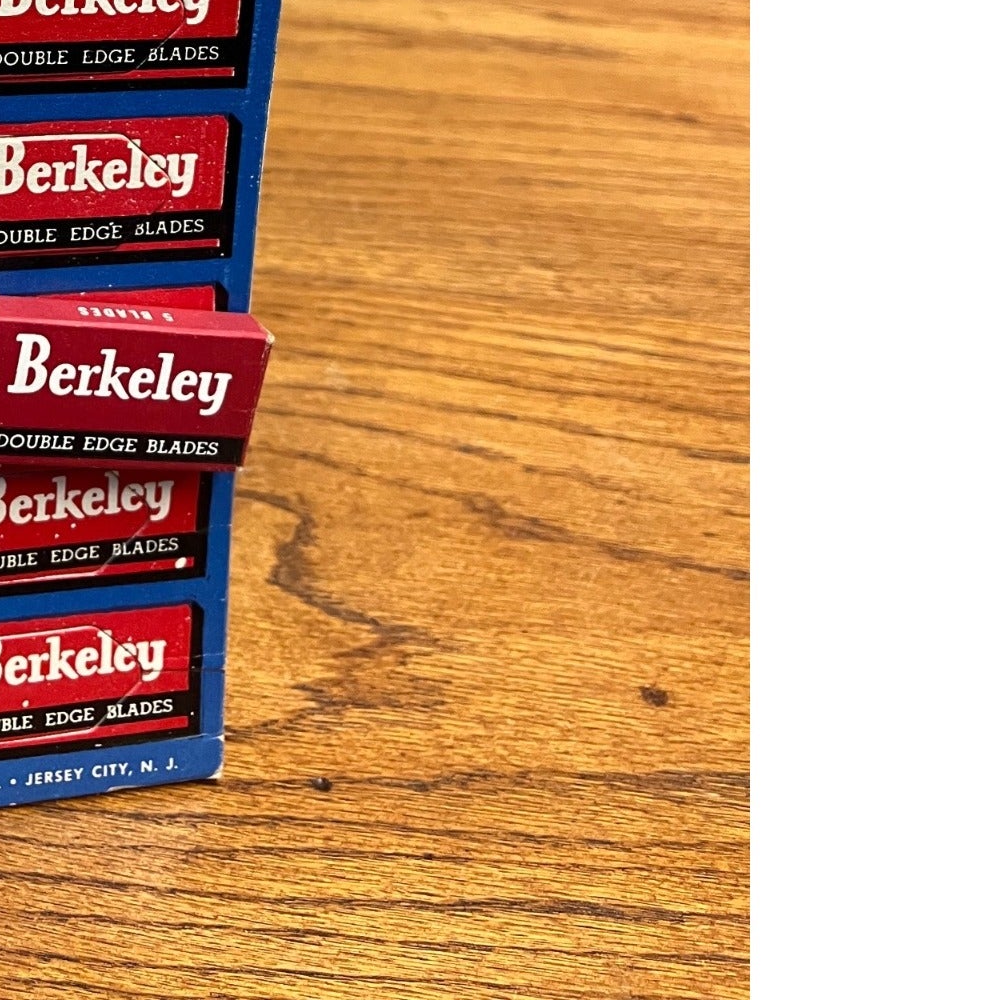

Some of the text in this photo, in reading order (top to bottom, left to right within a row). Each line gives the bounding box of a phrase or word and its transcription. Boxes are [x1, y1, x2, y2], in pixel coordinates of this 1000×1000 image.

[82, 48, 136, 65] EDGE
[147, 46, 220, 62] BLADES
[70, 225, 123, 242] EDGE
[134, 219, 205, 236] BLADES
[77, 306, 154, 320] BLADES
[7, 333, 232, 416] Berkeley
[82, 436, 138, 452] EDGE
[146, 440, 219, 456] BLADES
[50, 545, 100, 564] EDGE
[112, 537, 179, 556] BLADES
[45, 708, 95, 726] EDGE
[106, 699, 174, 720] BLADES
[25, 767, 83, 786] JERSEY
[91, 762, 133, 778] CITY,
